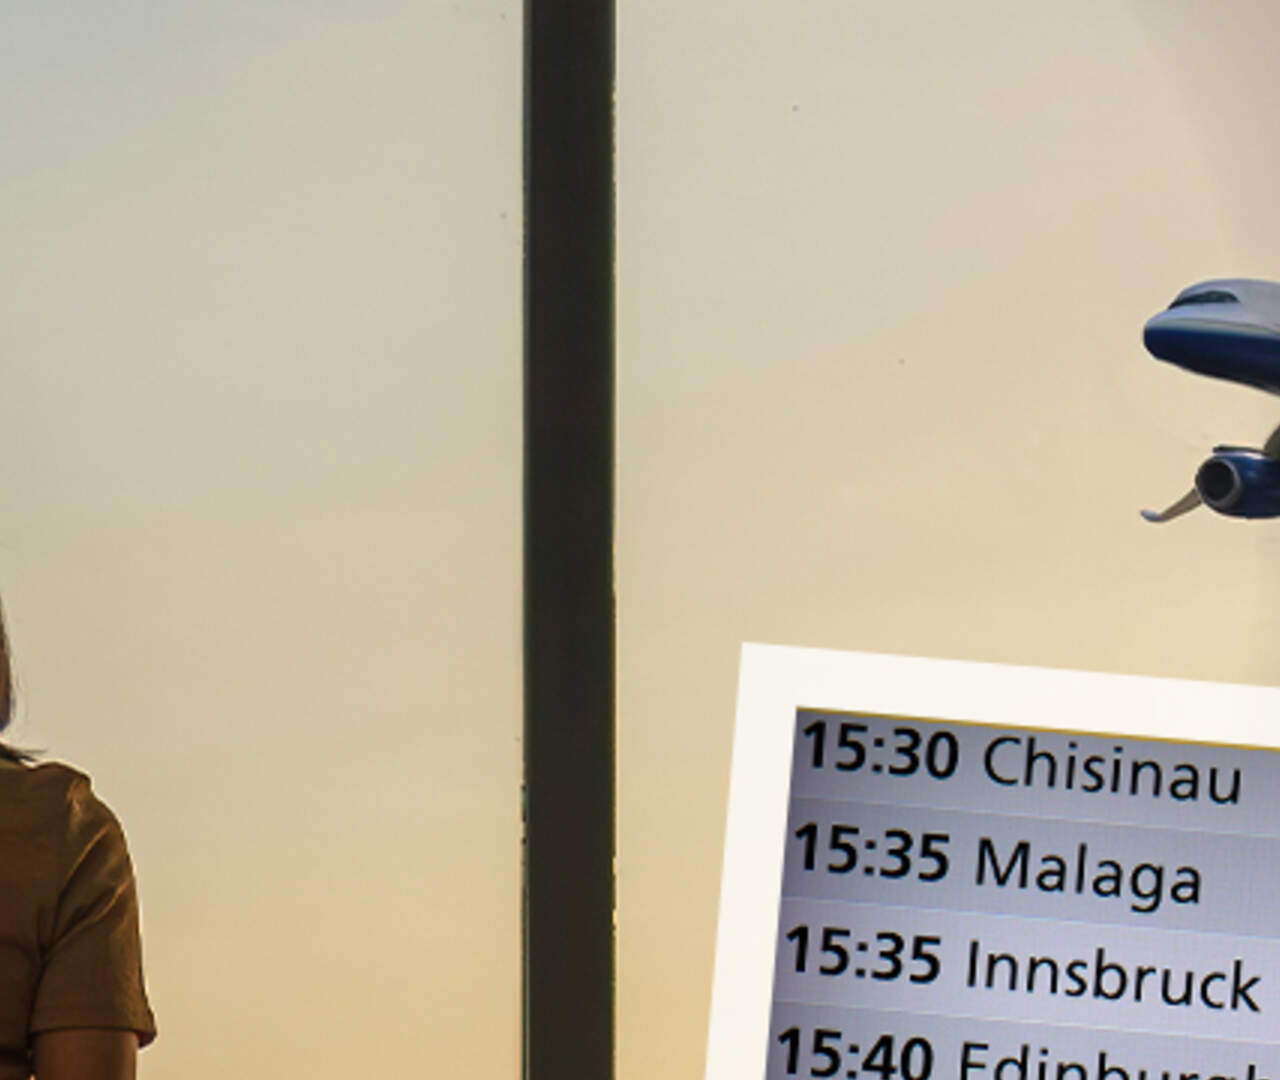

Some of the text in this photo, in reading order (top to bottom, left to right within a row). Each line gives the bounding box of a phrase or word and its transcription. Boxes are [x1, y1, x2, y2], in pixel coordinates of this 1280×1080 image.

[800, 717, 960, 780] 15:30
[982, 735, 1242, 805] Chisinau
[792, 820, 951, 882] 15:35
[975, 836, 1202, 914] Malaga
[784, 924, 942, 984] 15:35
[967, 939, 1260, 1013] Innsbruck
